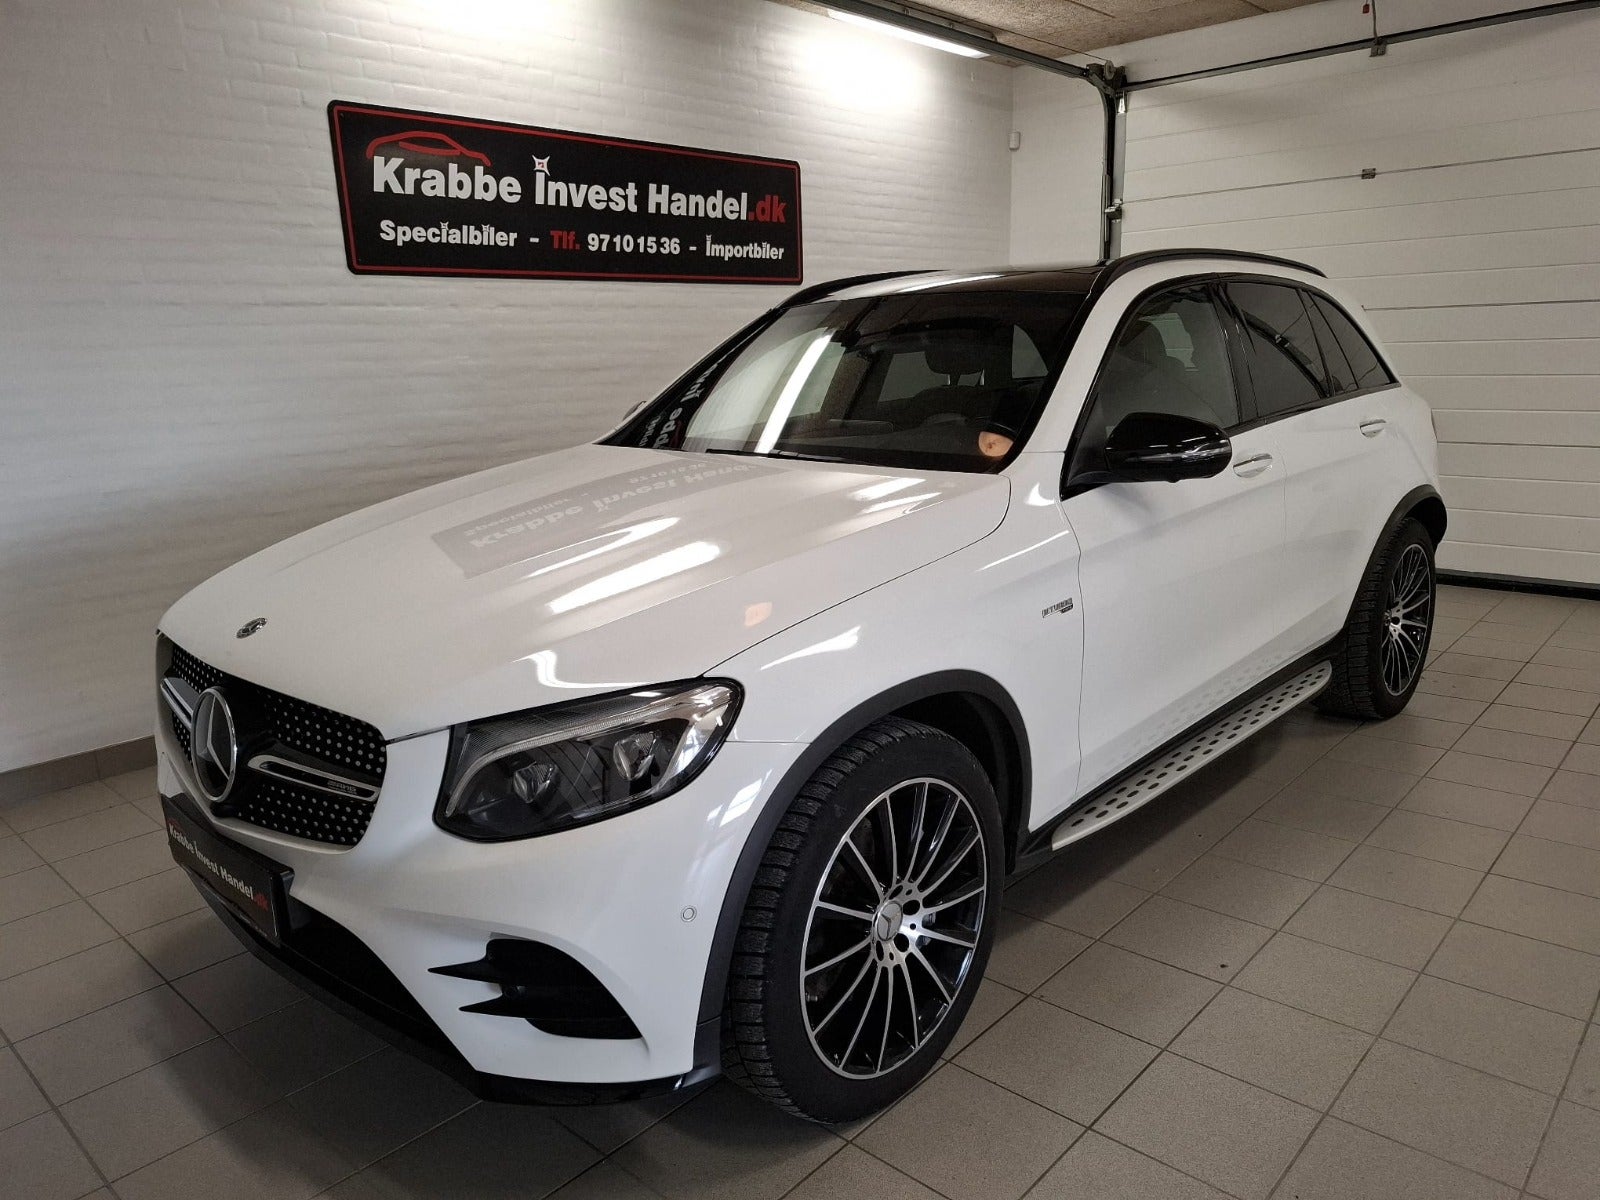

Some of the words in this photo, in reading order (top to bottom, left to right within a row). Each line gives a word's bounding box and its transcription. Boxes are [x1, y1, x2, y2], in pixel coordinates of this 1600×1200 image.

[372, 155, 522, 203] Krabbe
[532, 155, 637, 213] Invest
[648, 183, 787, 224] Handel.dk
[379, 220, 517, 248] Specialbiler
[550, 230, 581, 250] Tlf.
[705, 234, 785, 260] Importbiler
